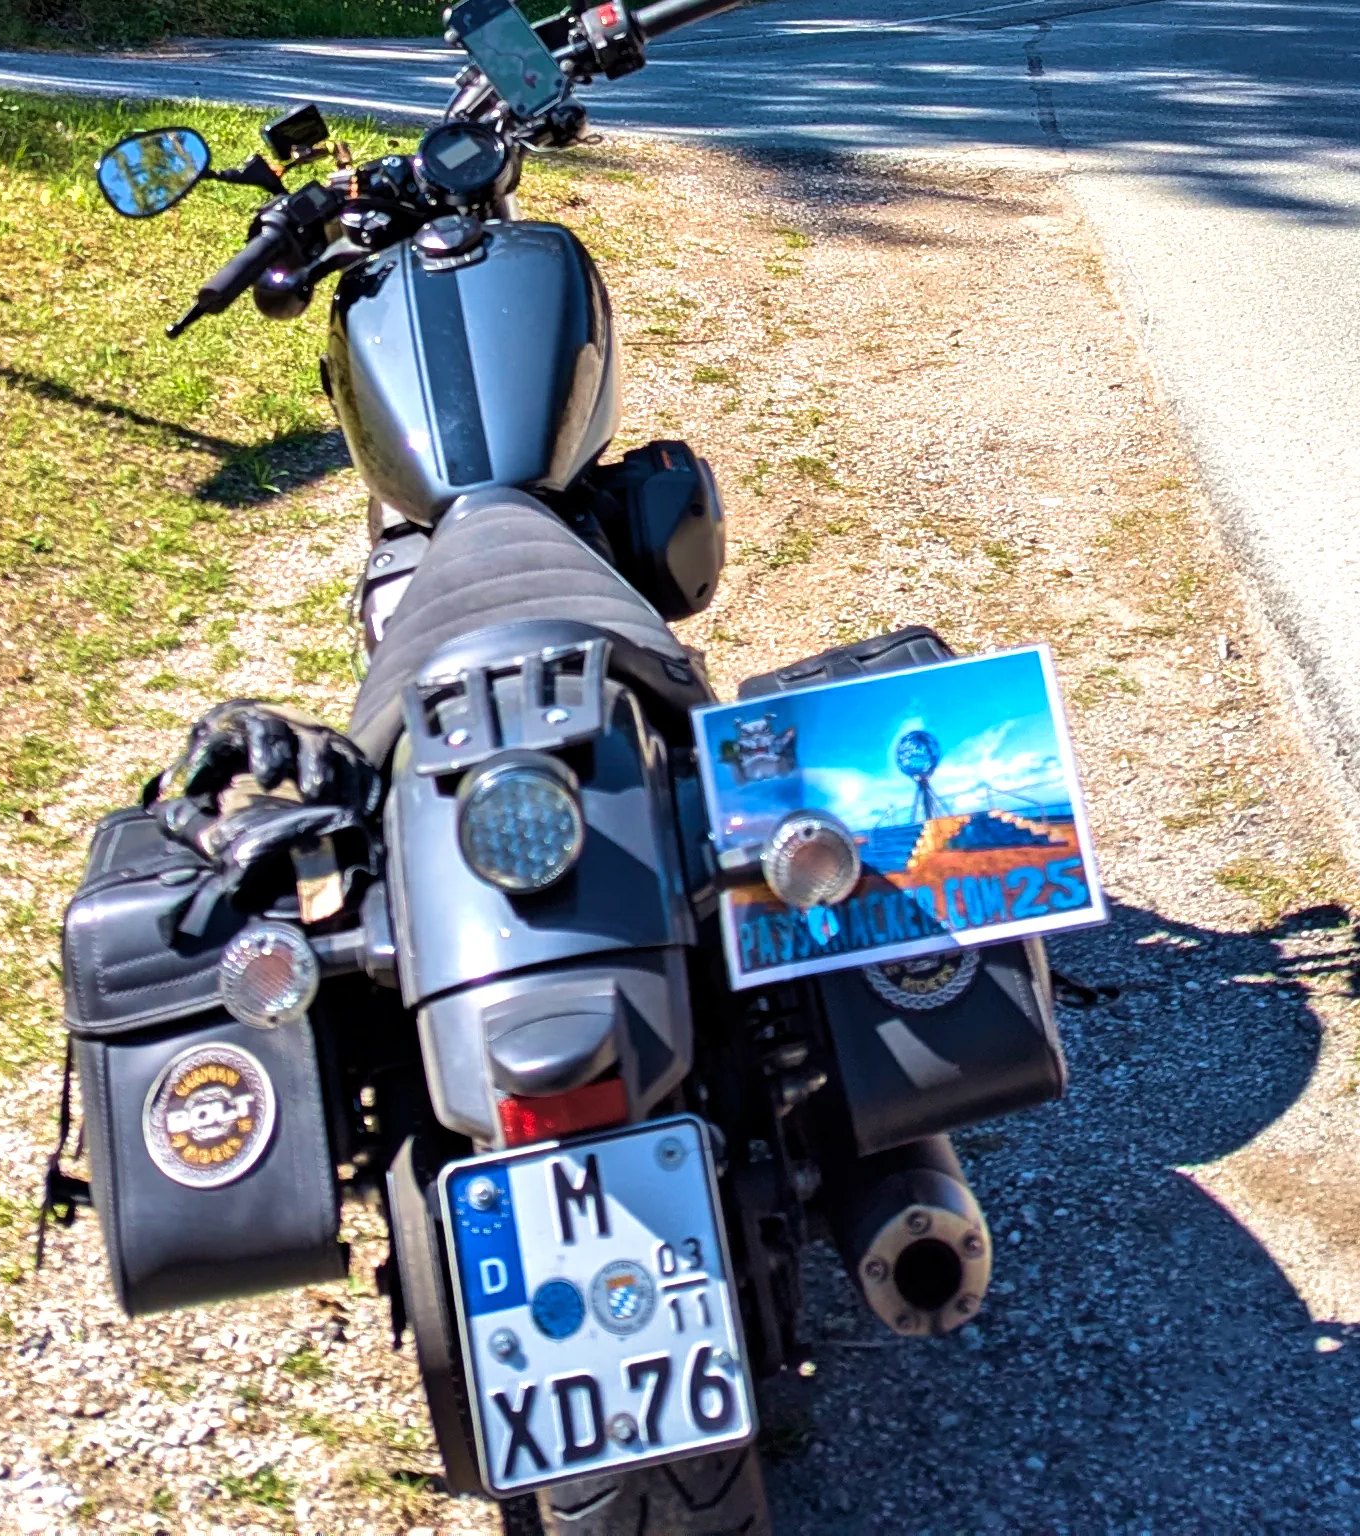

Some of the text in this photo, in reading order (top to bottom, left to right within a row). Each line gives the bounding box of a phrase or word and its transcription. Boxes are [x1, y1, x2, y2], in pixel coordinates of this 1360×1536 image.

[1005, 856, 1088, 919] 25
[551, 1153, 611, 1245] M
[479, 1257, 509, 1295] D
[658, 1237, 703, 1276] 03
[669, 1292, 712, 1334] 11
